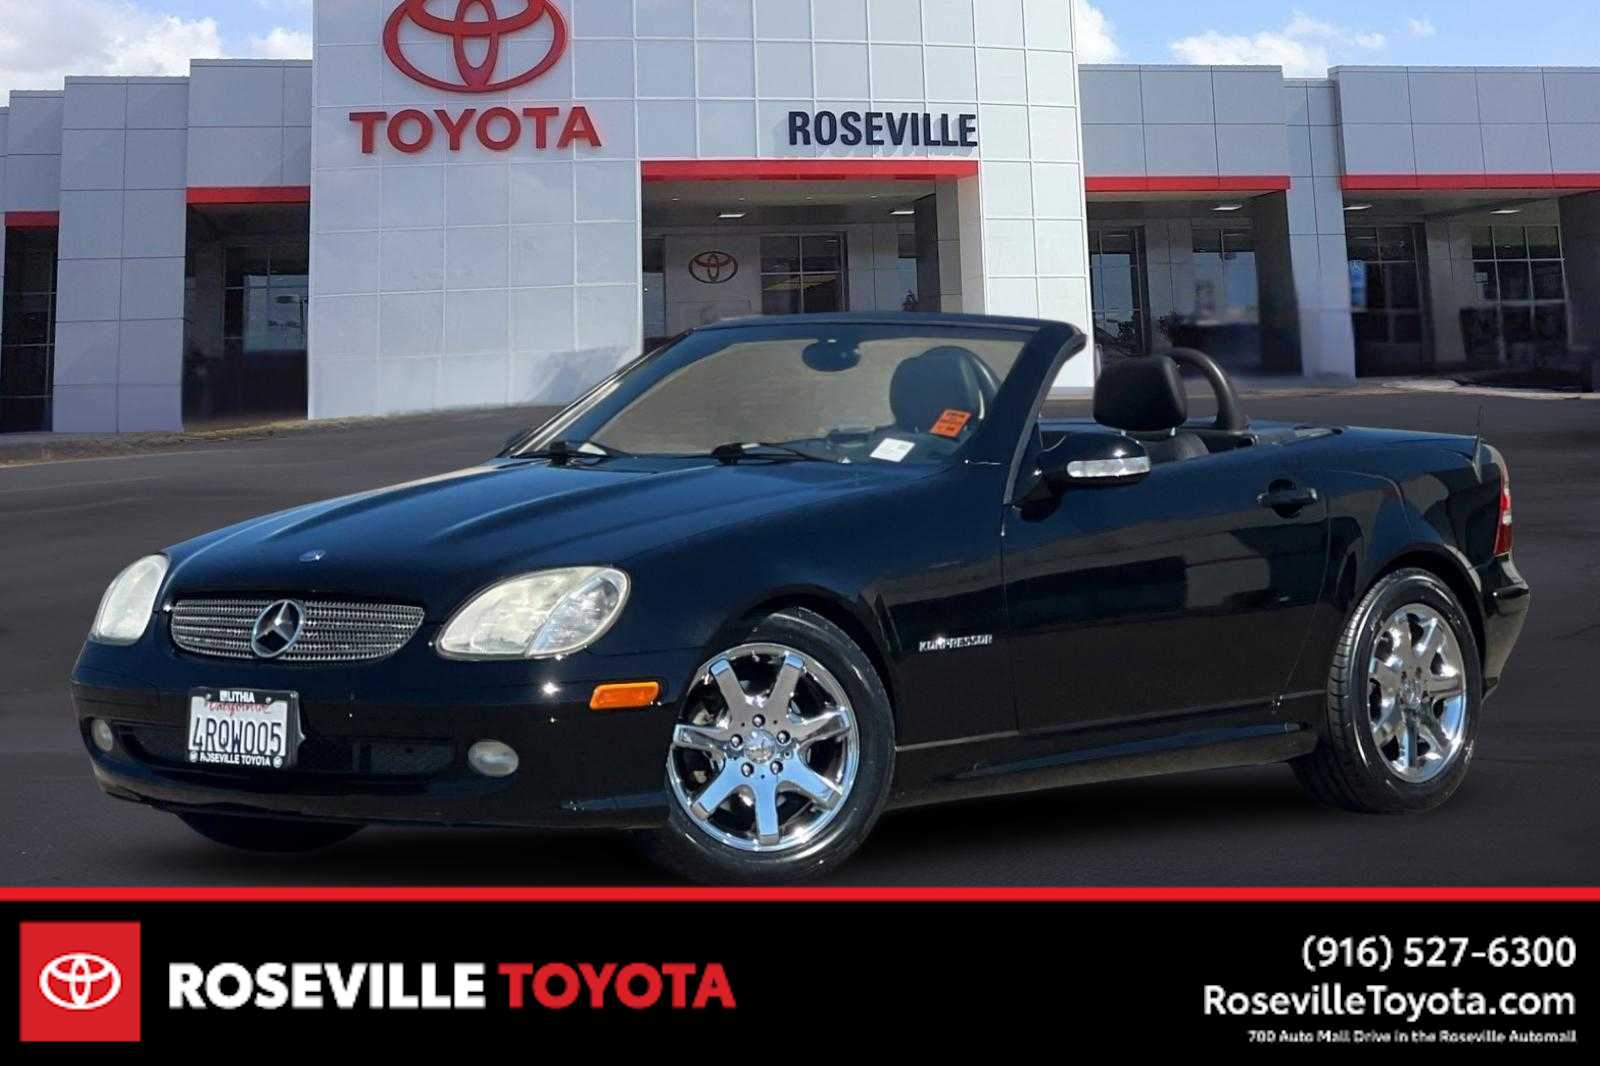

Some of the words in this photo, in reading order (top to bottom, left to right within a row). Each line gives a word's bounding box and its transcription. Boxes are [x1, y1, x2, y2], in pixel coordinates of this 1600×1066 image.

[350, 106, 602, 154] TOYOTA
[788, 110, 978, 148] ROSEVILLE
[192, 717, 283, 754] 4RQW005
[200, 751, 240, 765] ROSEVILLE
[242, 755, 271, 766] TOYOTA
